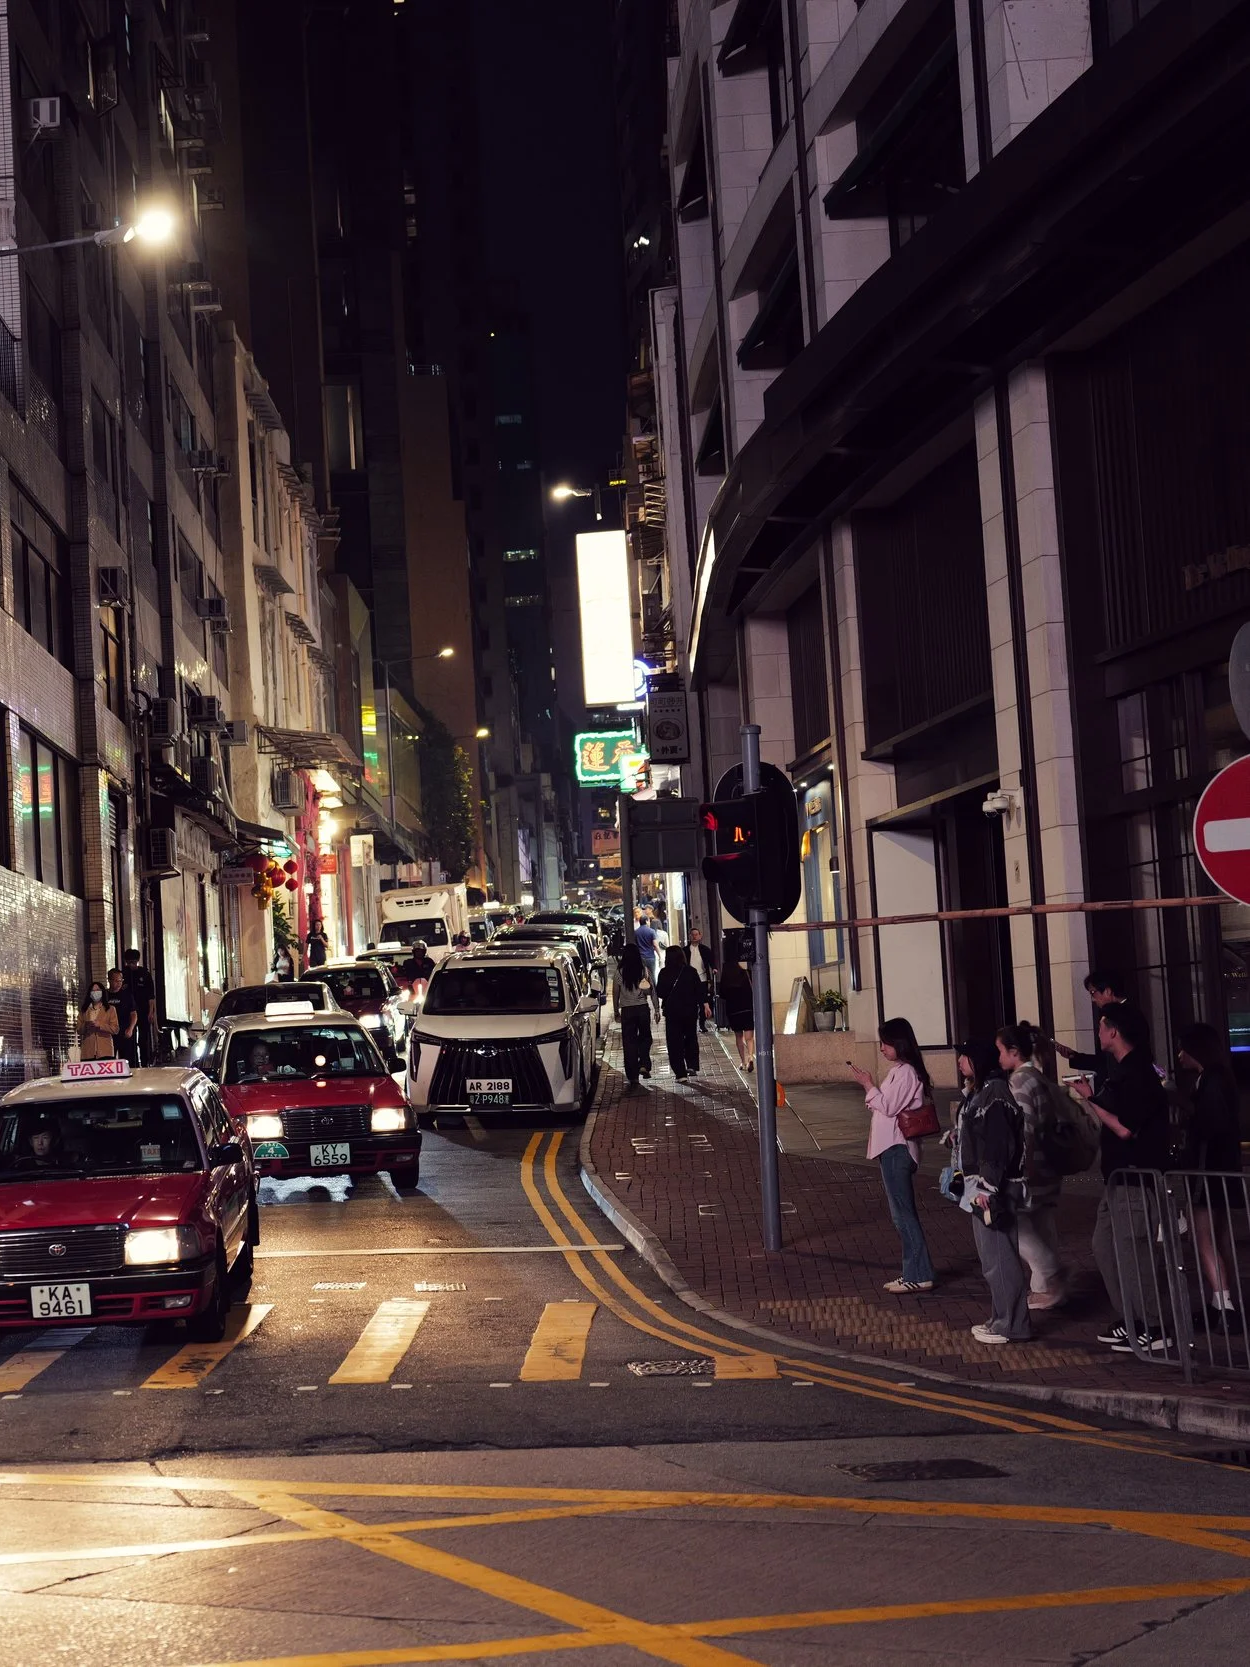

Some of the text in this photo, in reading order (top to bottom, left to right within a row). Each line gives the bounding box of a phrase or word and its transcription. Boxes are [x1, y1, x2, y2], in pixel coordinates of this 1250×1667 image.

[67, 1061, 124, 1077] TAXI
[469, 1081, 510, 1091] AR 2188
[321, 1144, 339, 1156] KY
[313, 1153, 348, 1166] 6559
[48, 1286, 73, 1301] KA
[39, 1300, 84, 1316] 9461
